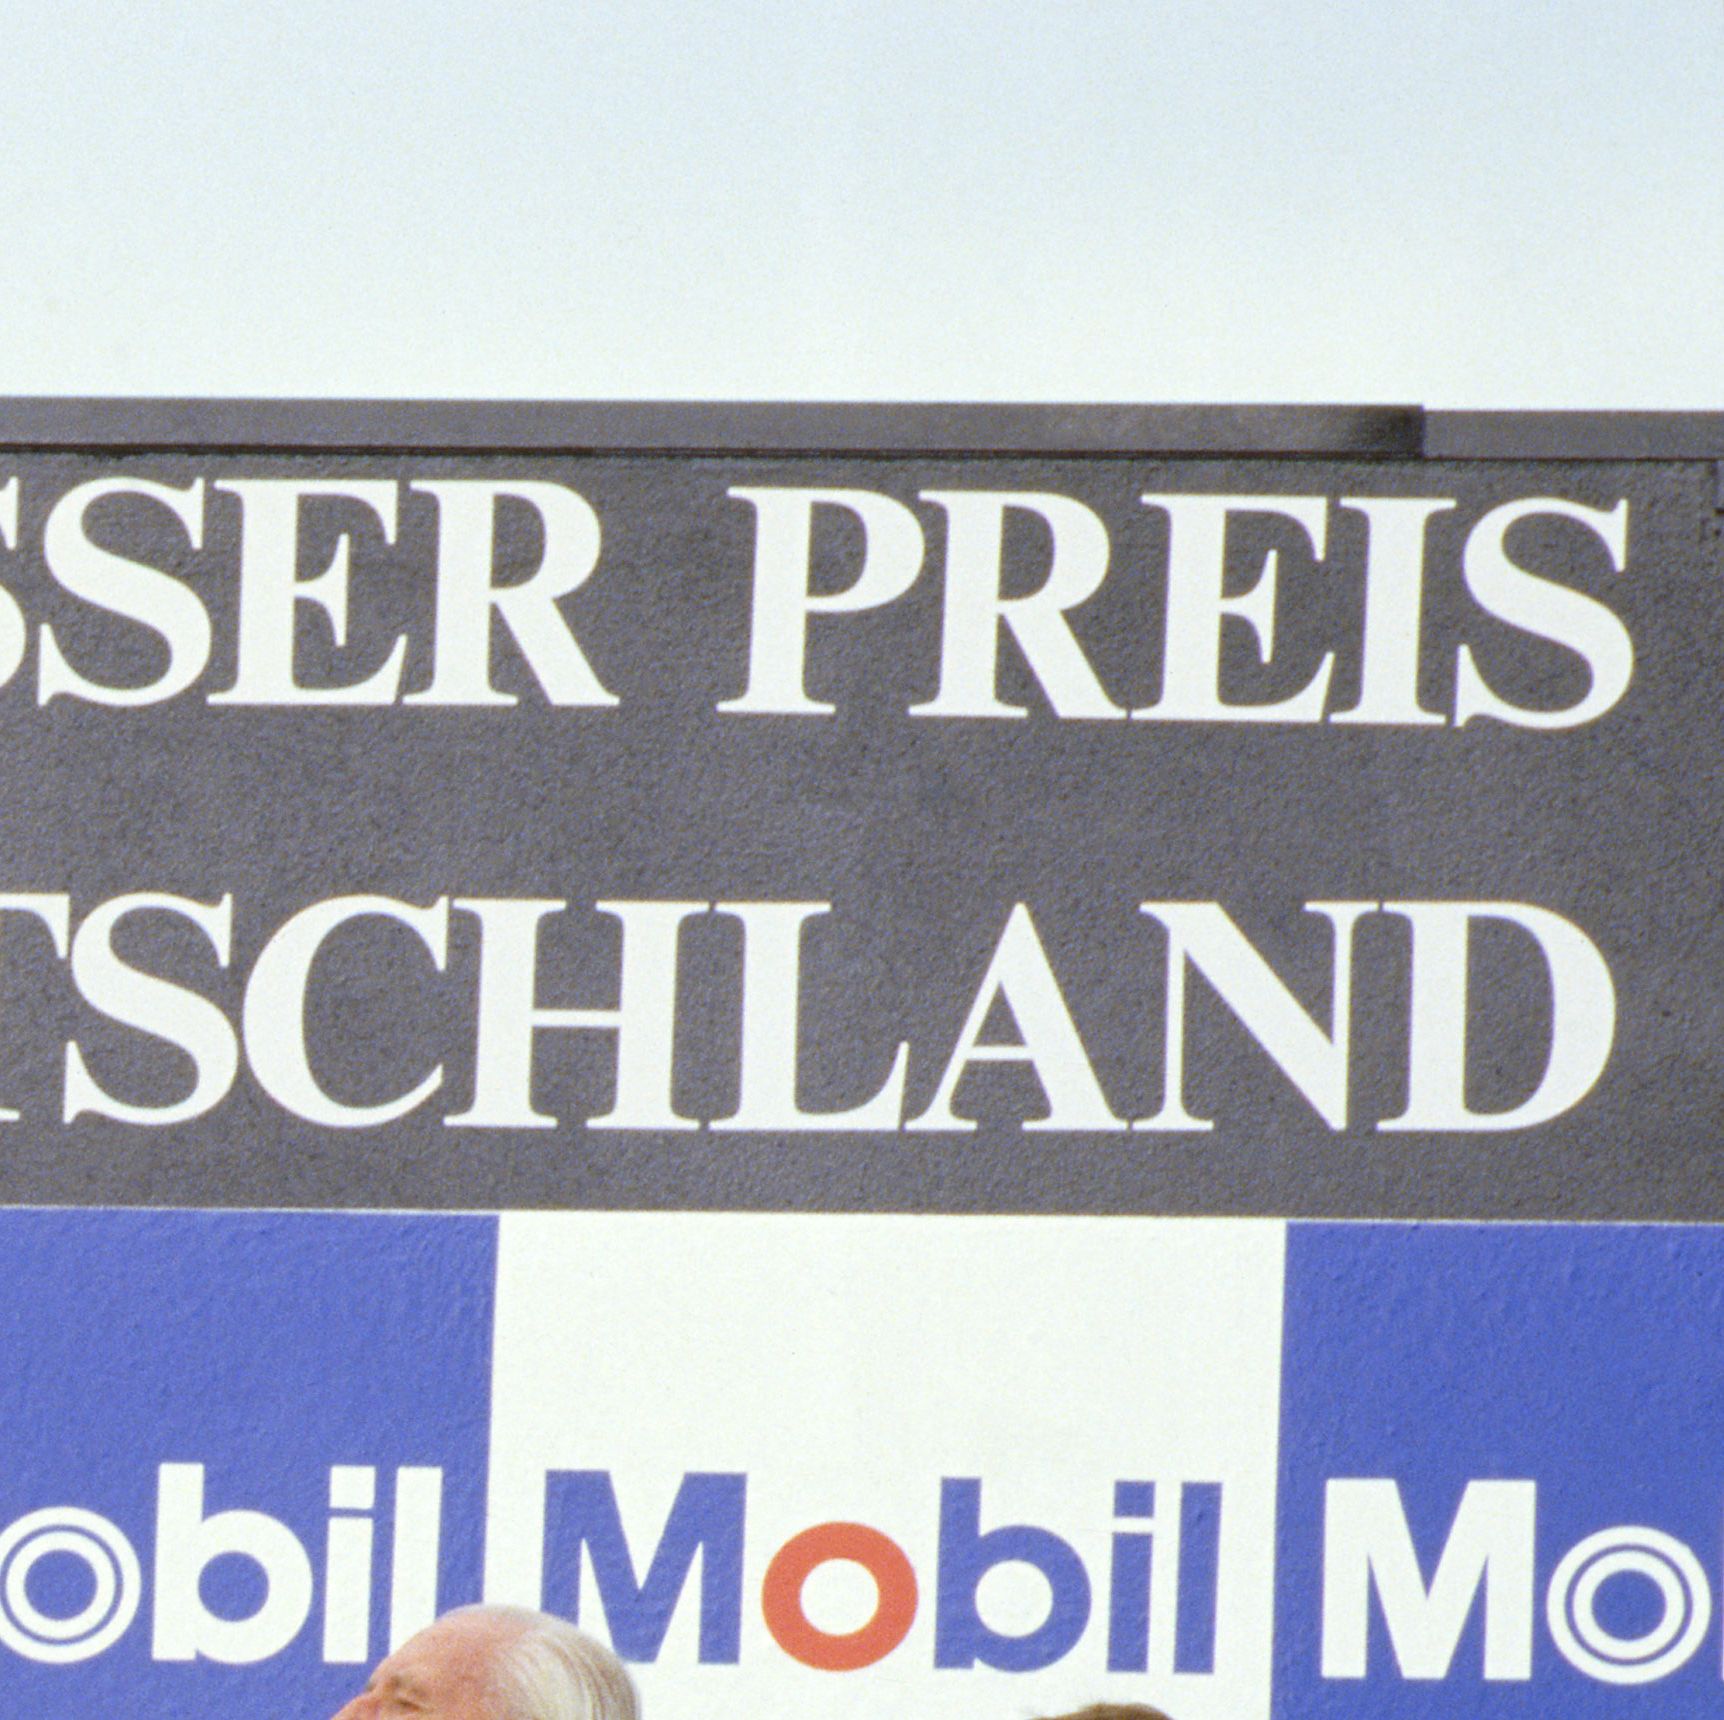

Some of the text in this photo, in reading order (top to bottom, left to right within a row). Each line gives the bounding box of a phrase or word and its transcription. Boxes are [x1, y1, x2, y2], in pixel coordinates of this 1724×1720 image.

[716, 486, 1636, 730] PREIS
[539, 1469, 1223, 1675] Mobil
[1320, 1477, 1724, 1686] Mo
